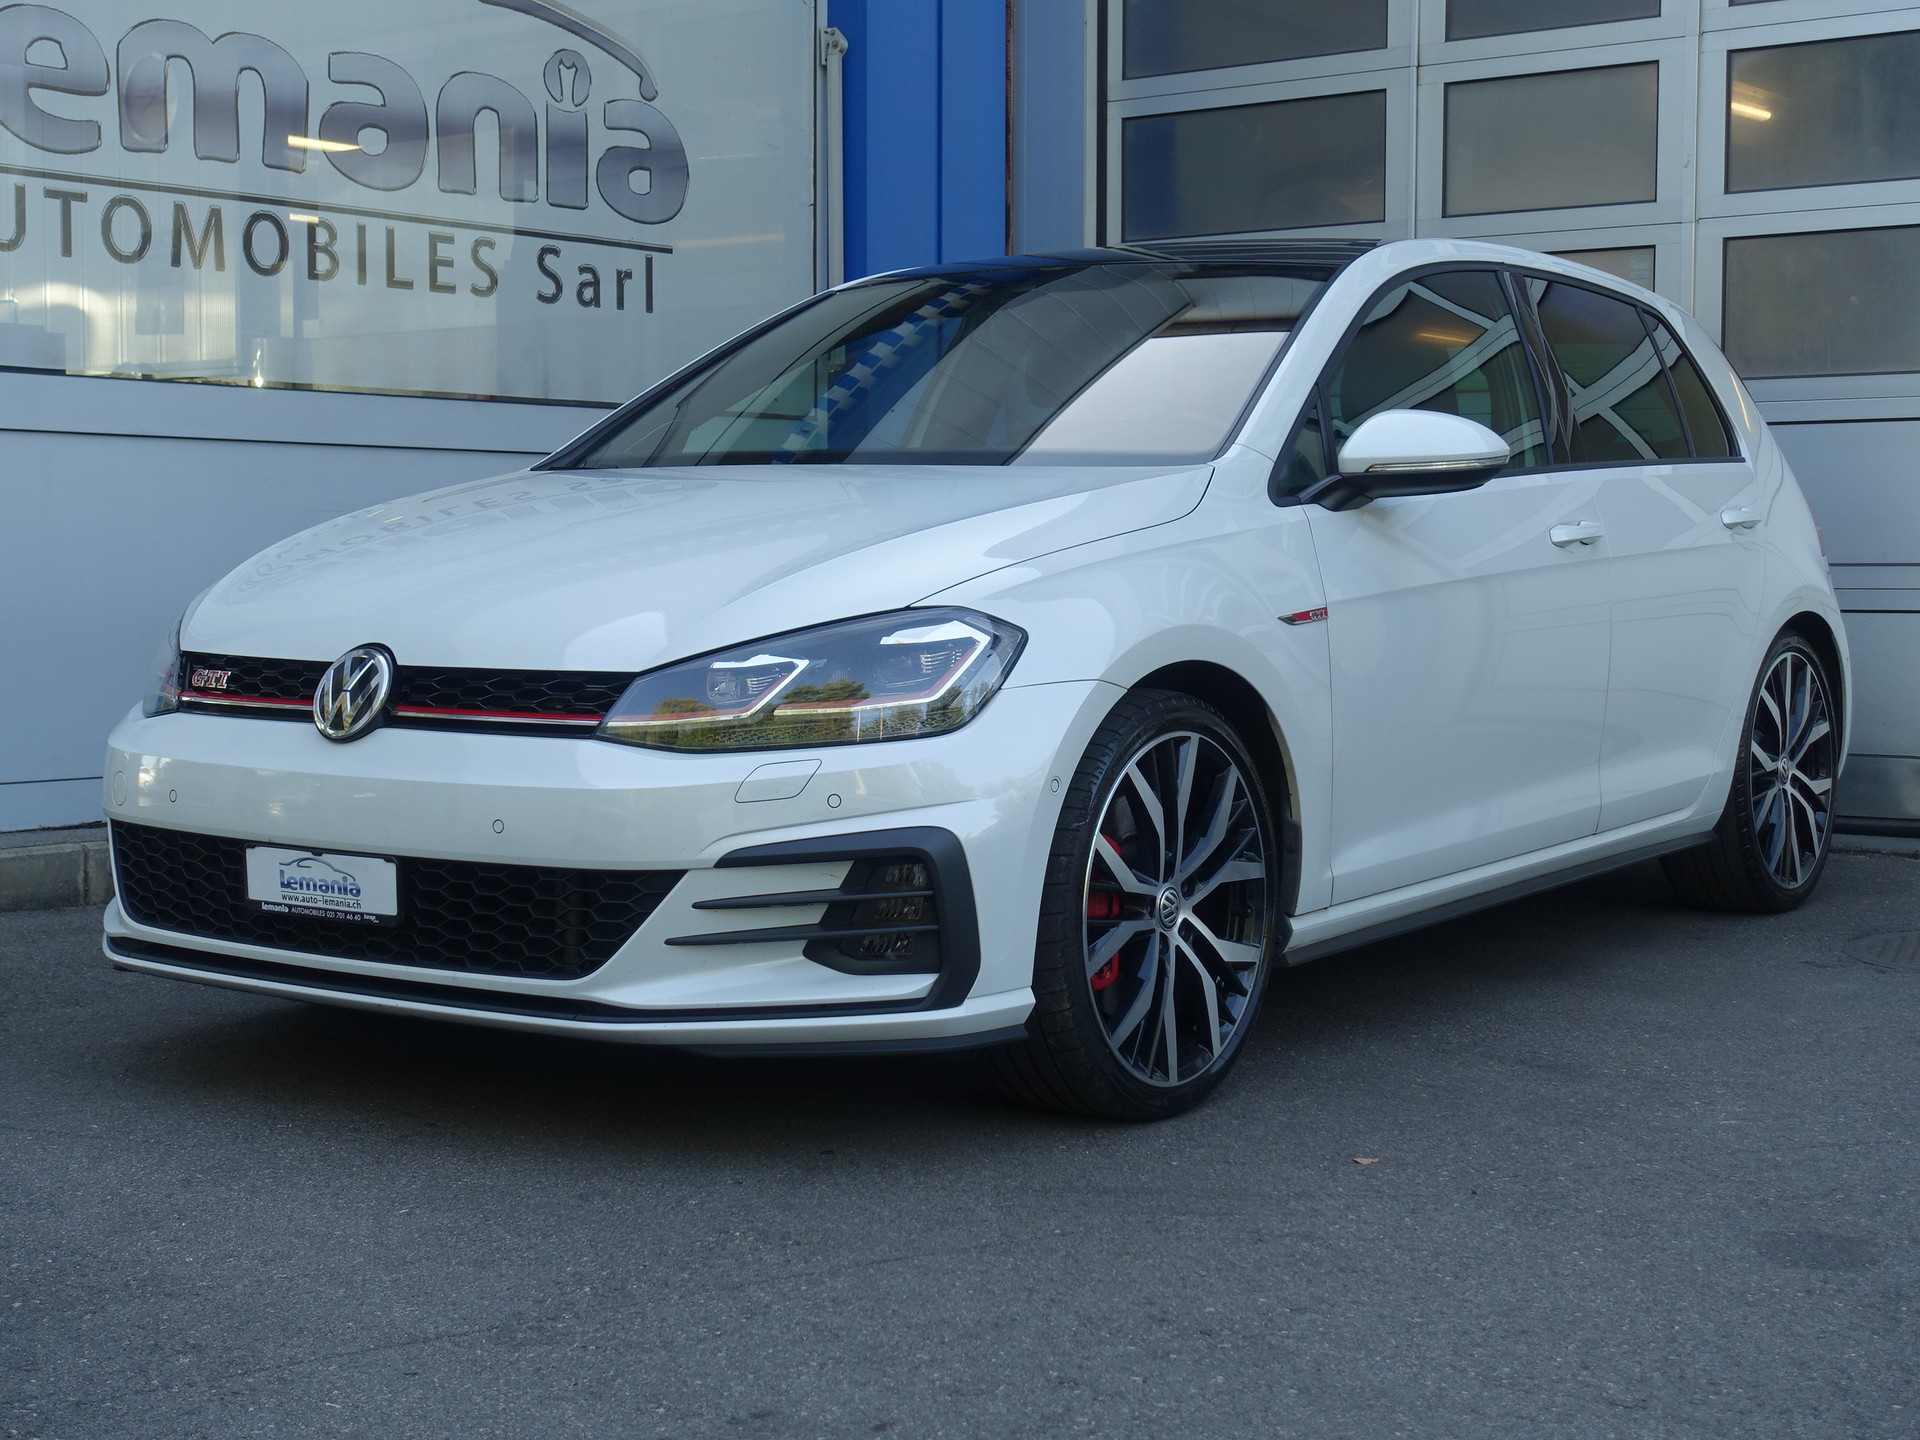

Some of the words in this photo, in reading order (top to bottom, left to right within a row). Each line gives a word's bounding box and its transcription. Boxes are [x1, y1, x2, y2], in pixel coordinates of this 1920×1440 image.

[535, 244, 655, 314] Sarl
[191, 668, 232, 689] GTI
[279, 869, 362, 897] Lemania
[281, 893, 362, 910] www.auto-lemania.ch
[291, 906, 326, 917] AUTOMOBILES
